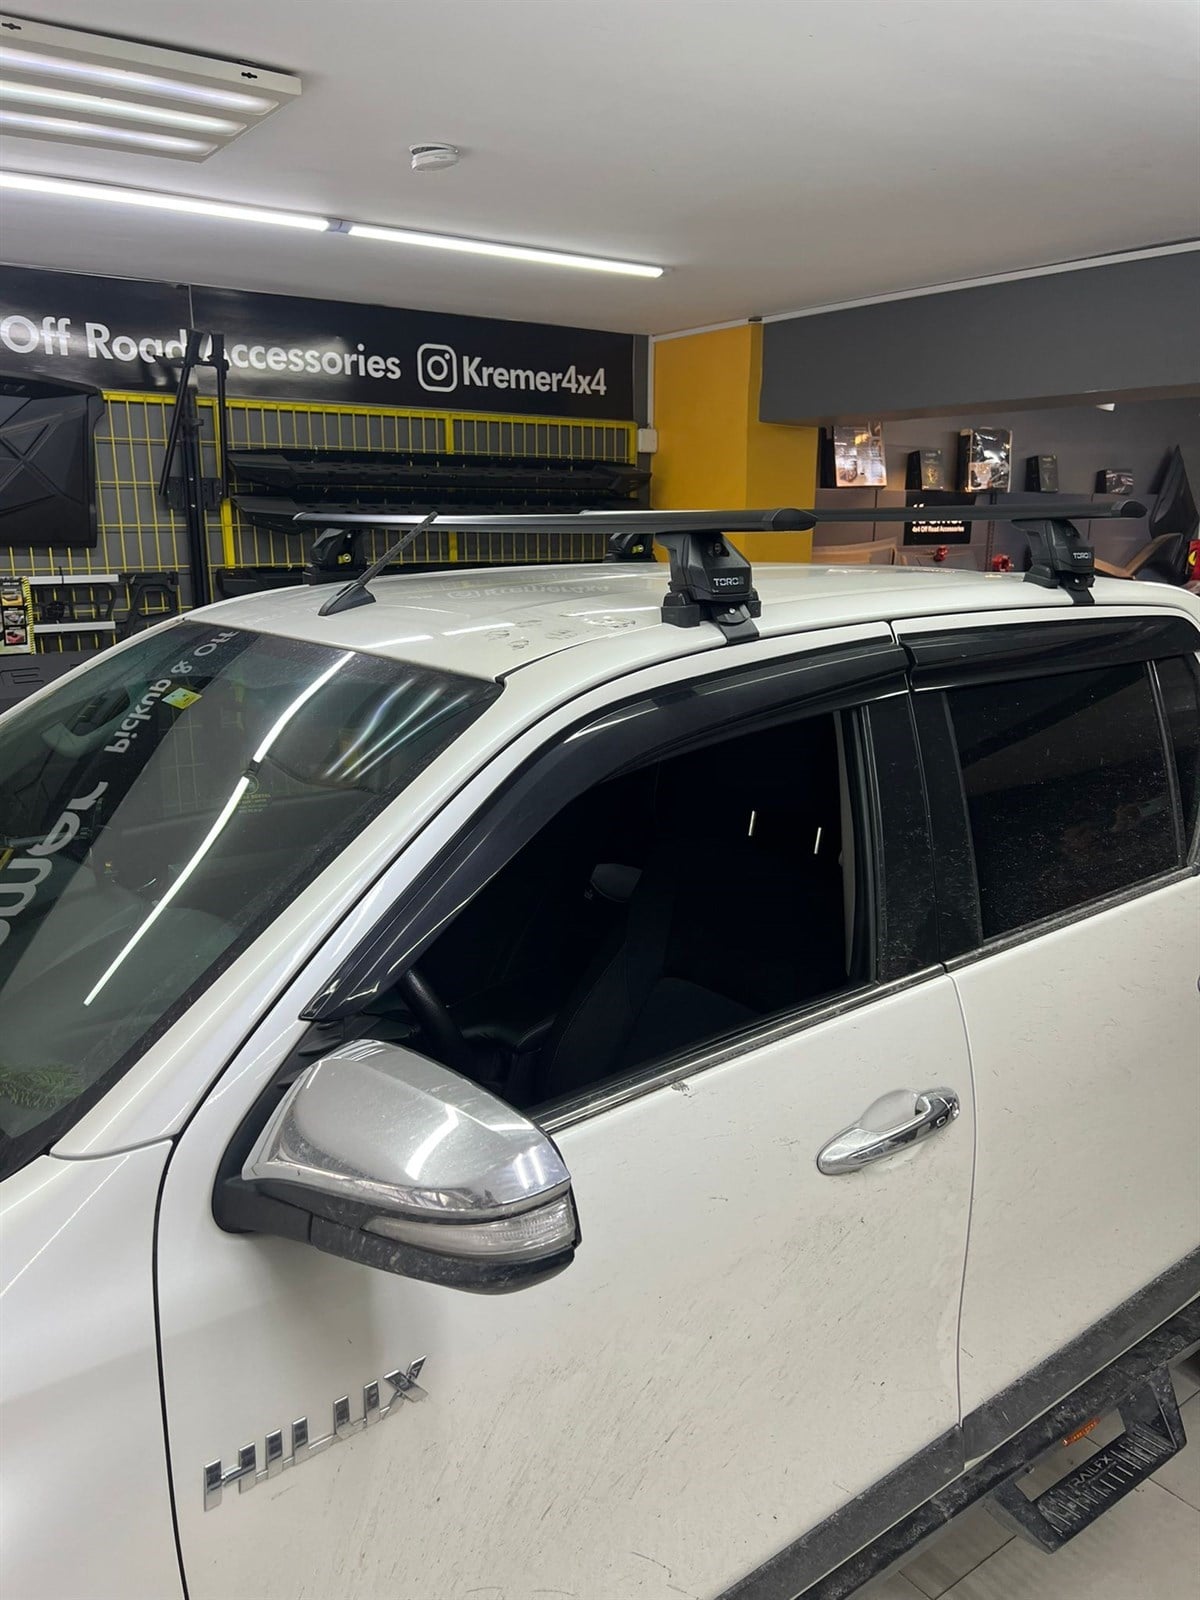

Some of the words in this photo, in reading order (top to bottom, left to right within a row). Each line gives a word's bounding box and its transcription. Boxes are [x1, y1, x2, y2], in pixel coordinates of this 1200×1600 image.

[0, 315, 72, 356] Off
[85, 322, 188, 363] Road
[462, 355, 607, 396] Kremer4x4
[204, 1354, 429, 1512] HILUX
